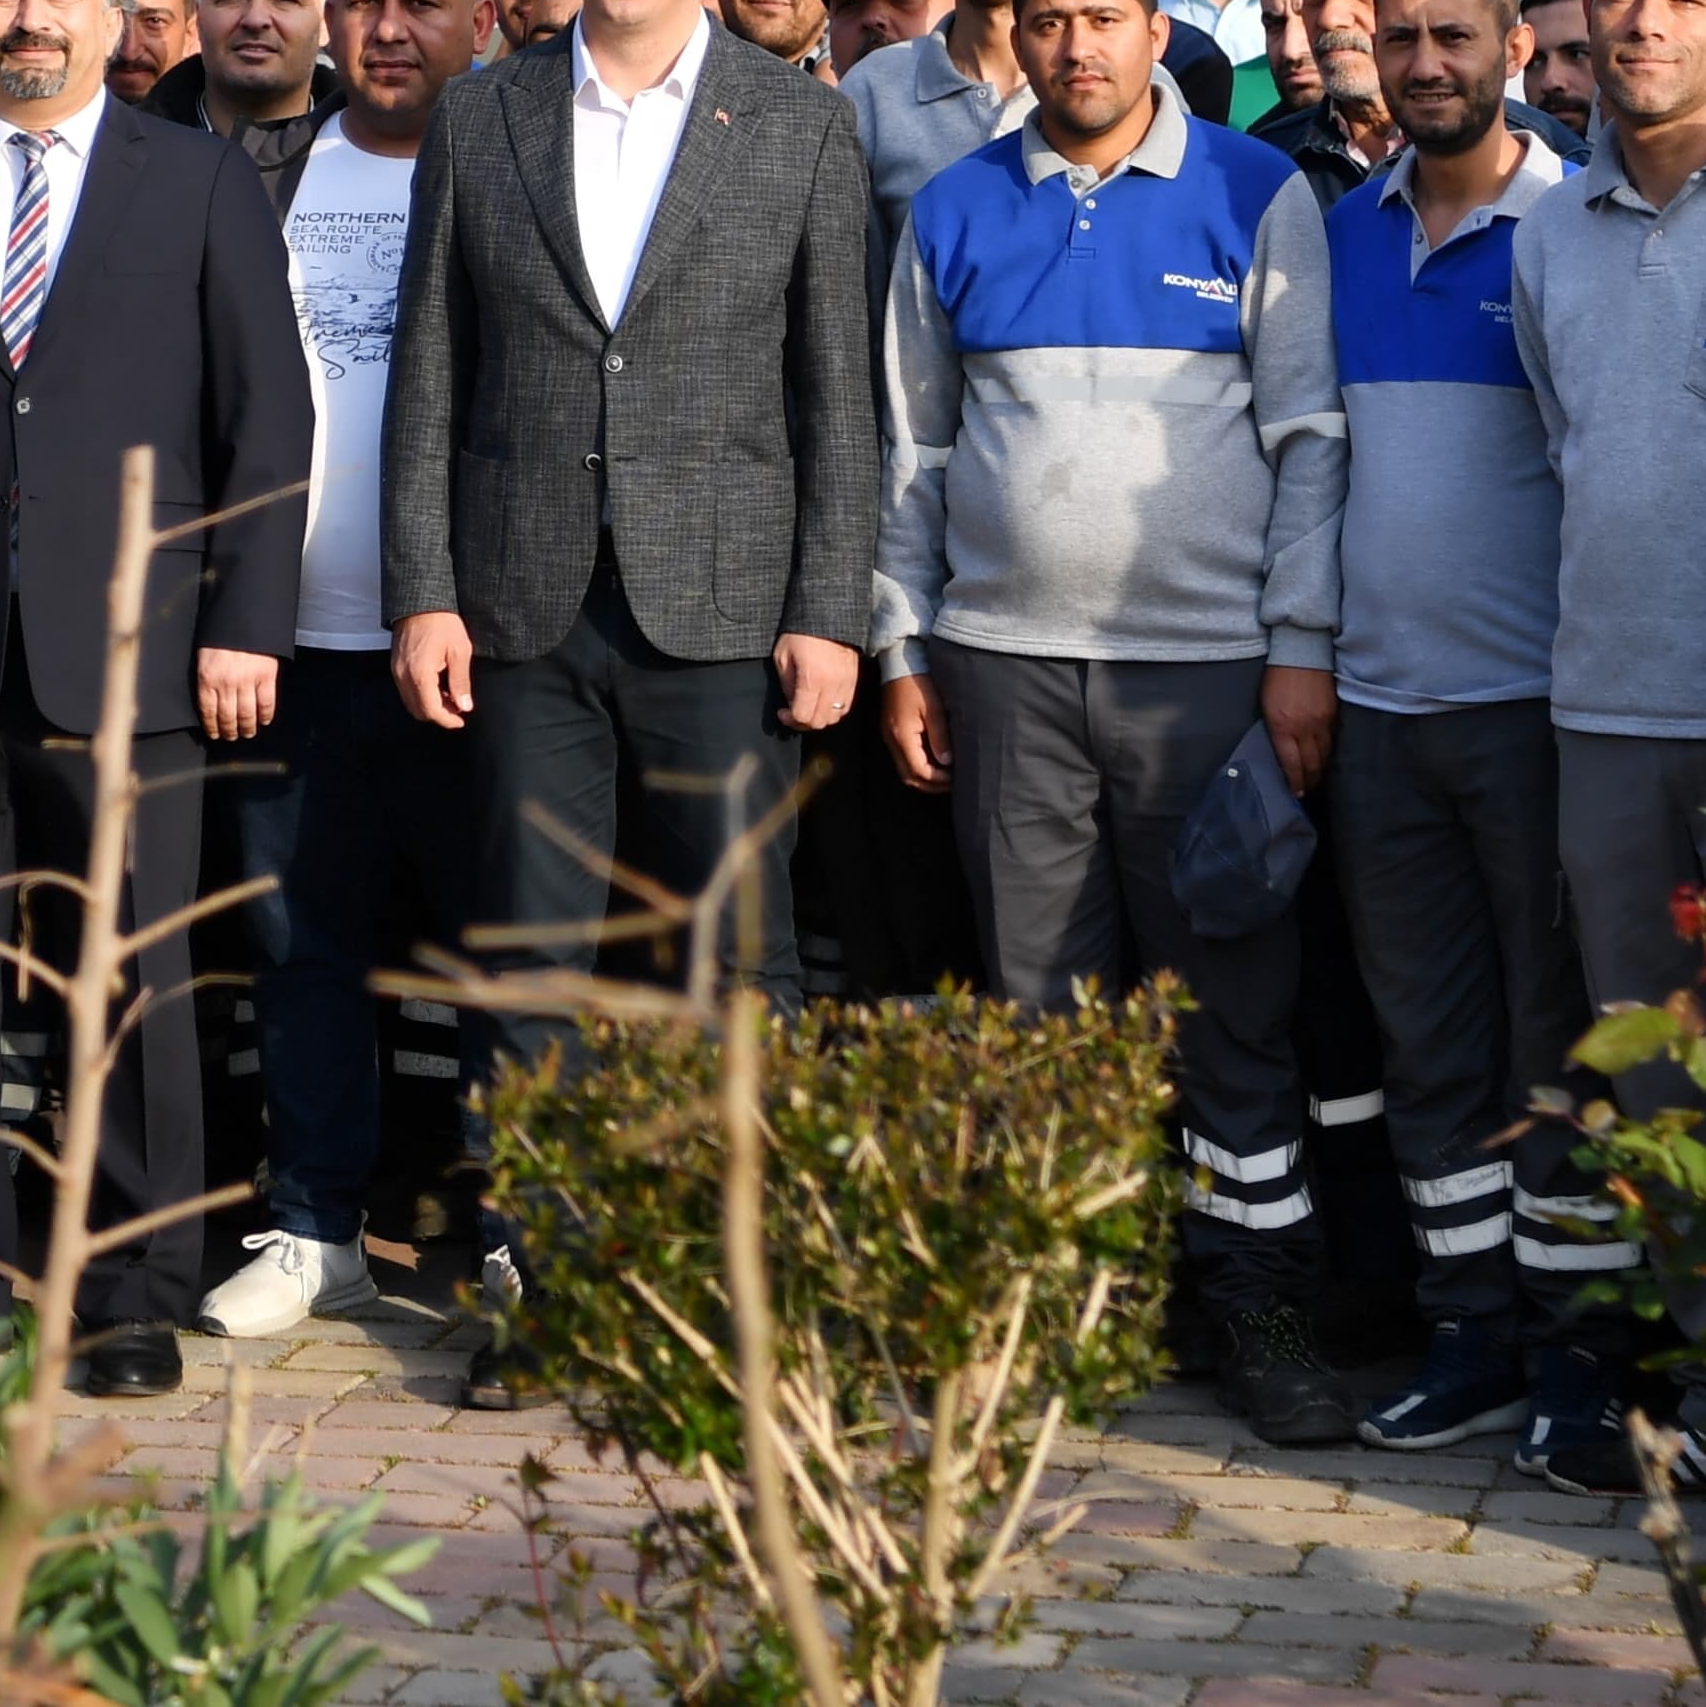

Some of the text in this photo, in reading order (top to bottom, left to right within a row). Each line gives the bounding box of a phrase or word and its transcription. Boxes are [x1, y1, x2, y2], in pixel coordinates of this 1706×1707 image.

[293, 212, 406, 224] NORTHERN
[290, 224, 382, 235] SEA ROUTE
[288, 234, 365, 245] EXTREME
